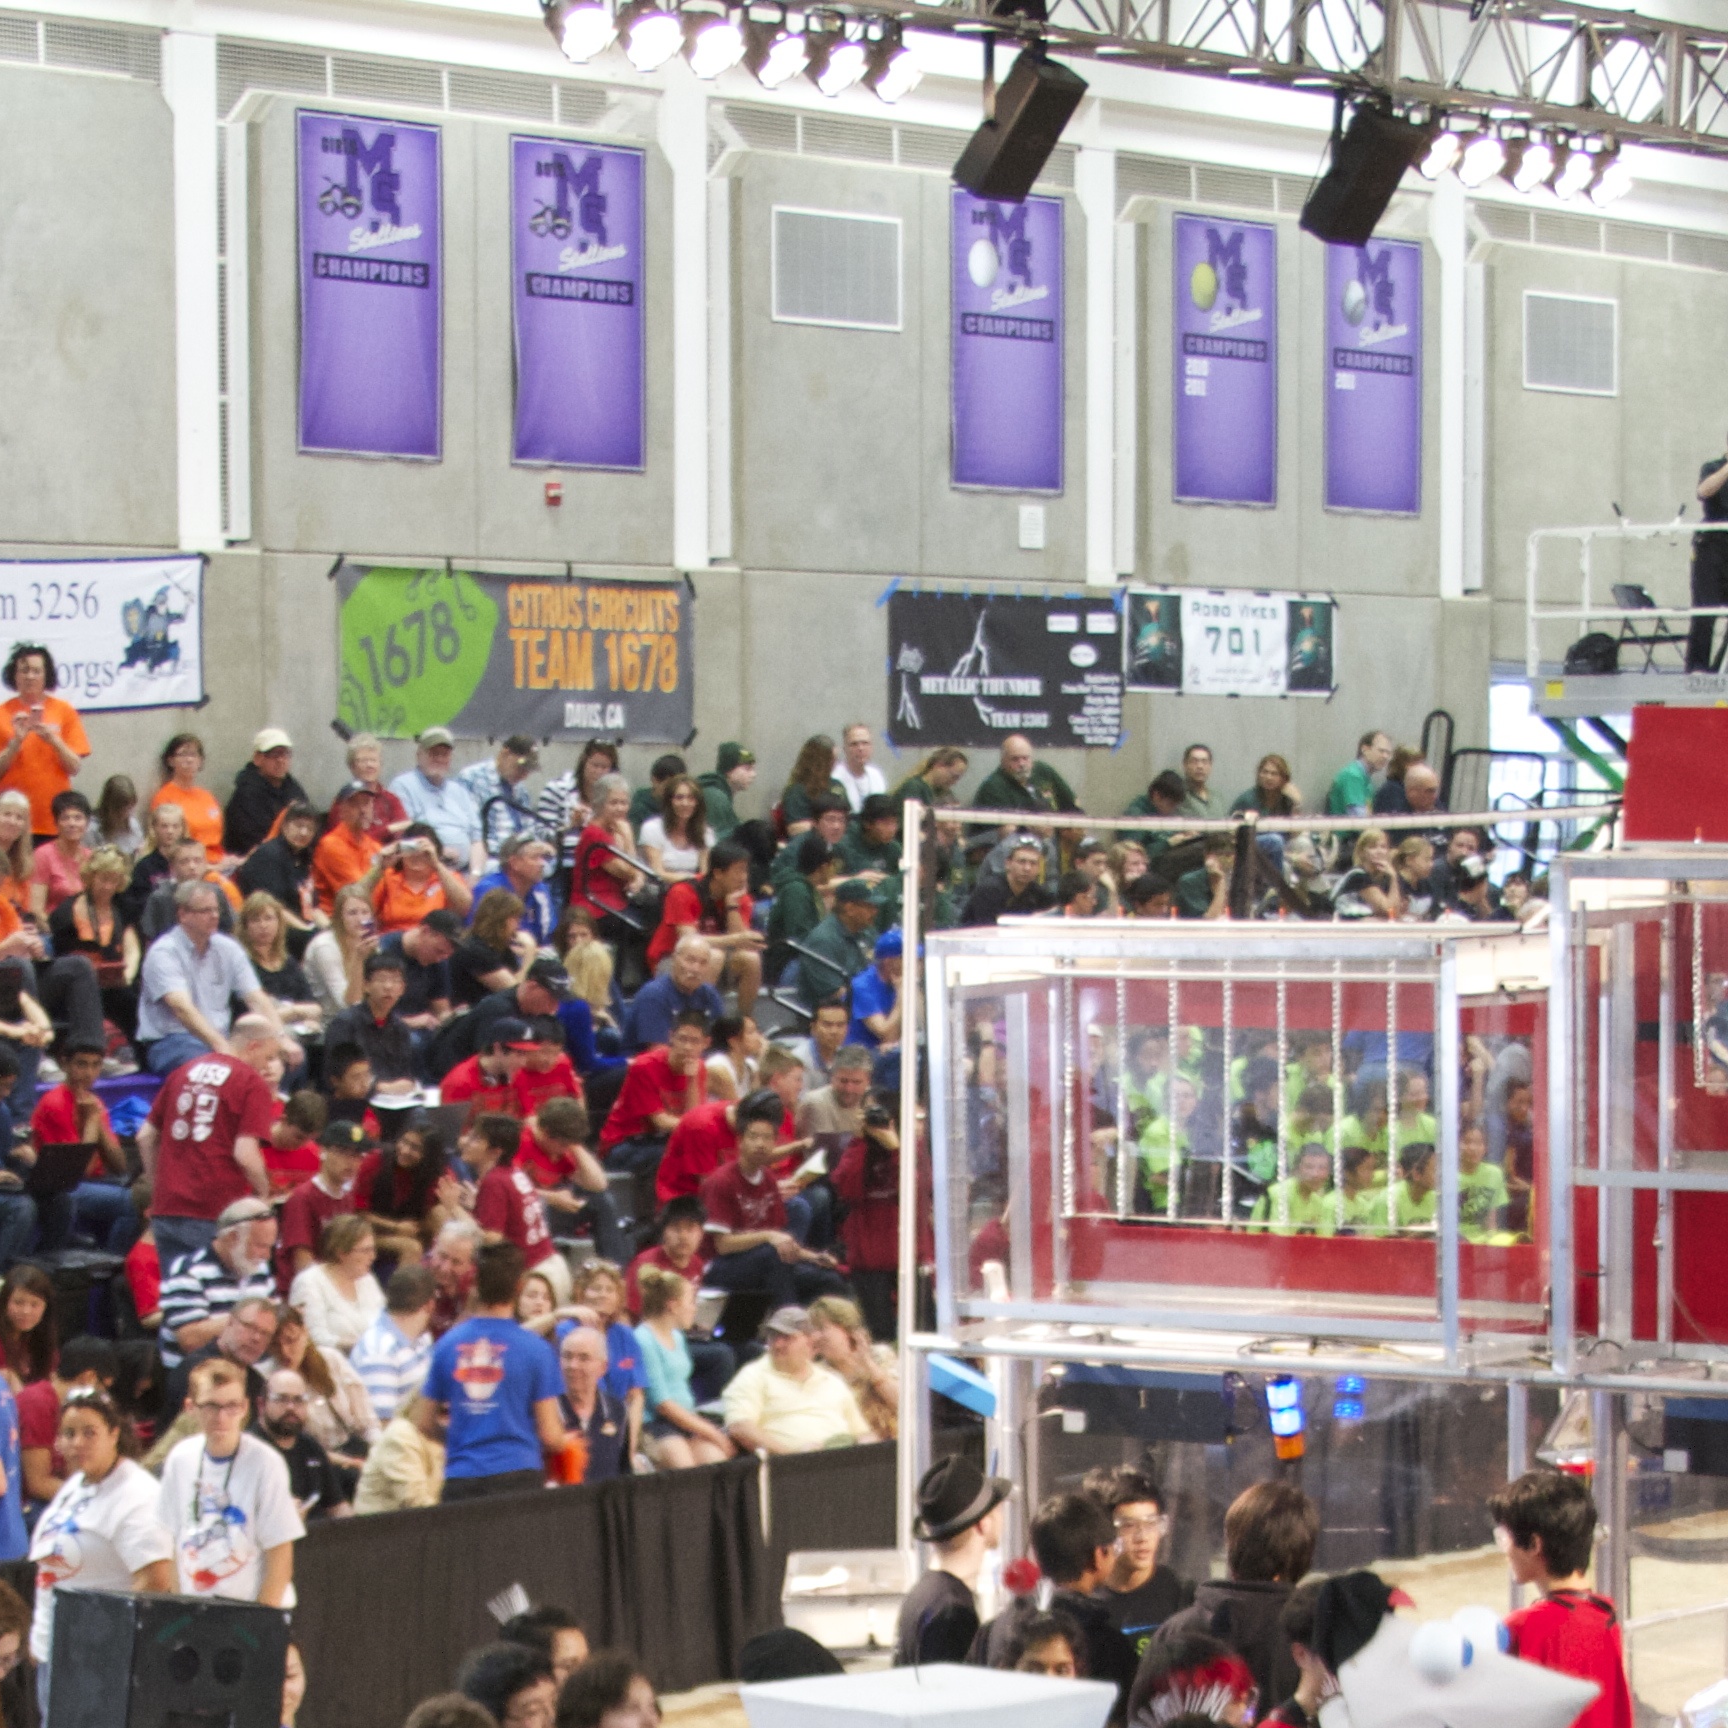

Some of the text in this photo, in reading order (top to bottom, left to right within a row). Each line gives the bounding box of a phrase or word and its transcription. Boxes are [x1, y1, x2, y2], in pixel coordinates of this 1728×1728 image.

[316, 257, 426, 286] CHAMPIONS
[530, 277, 630, 304] CHAMPIONS
[965, 317, 1052, 340] CHAMPIONS
[1186, 338, 1266, 358] CHAMPIONS
[1336, 351, 1412, 373] CHAMPIONS
[28, 581, 100, 621] 3256
[508, 583, 680, 633] CITRUS CIRCUITS
[359, 601, 461, 697] 1678
[1204, 626, 1262, 656] 701
[509, 628, 680, 693] TEAM 1678
